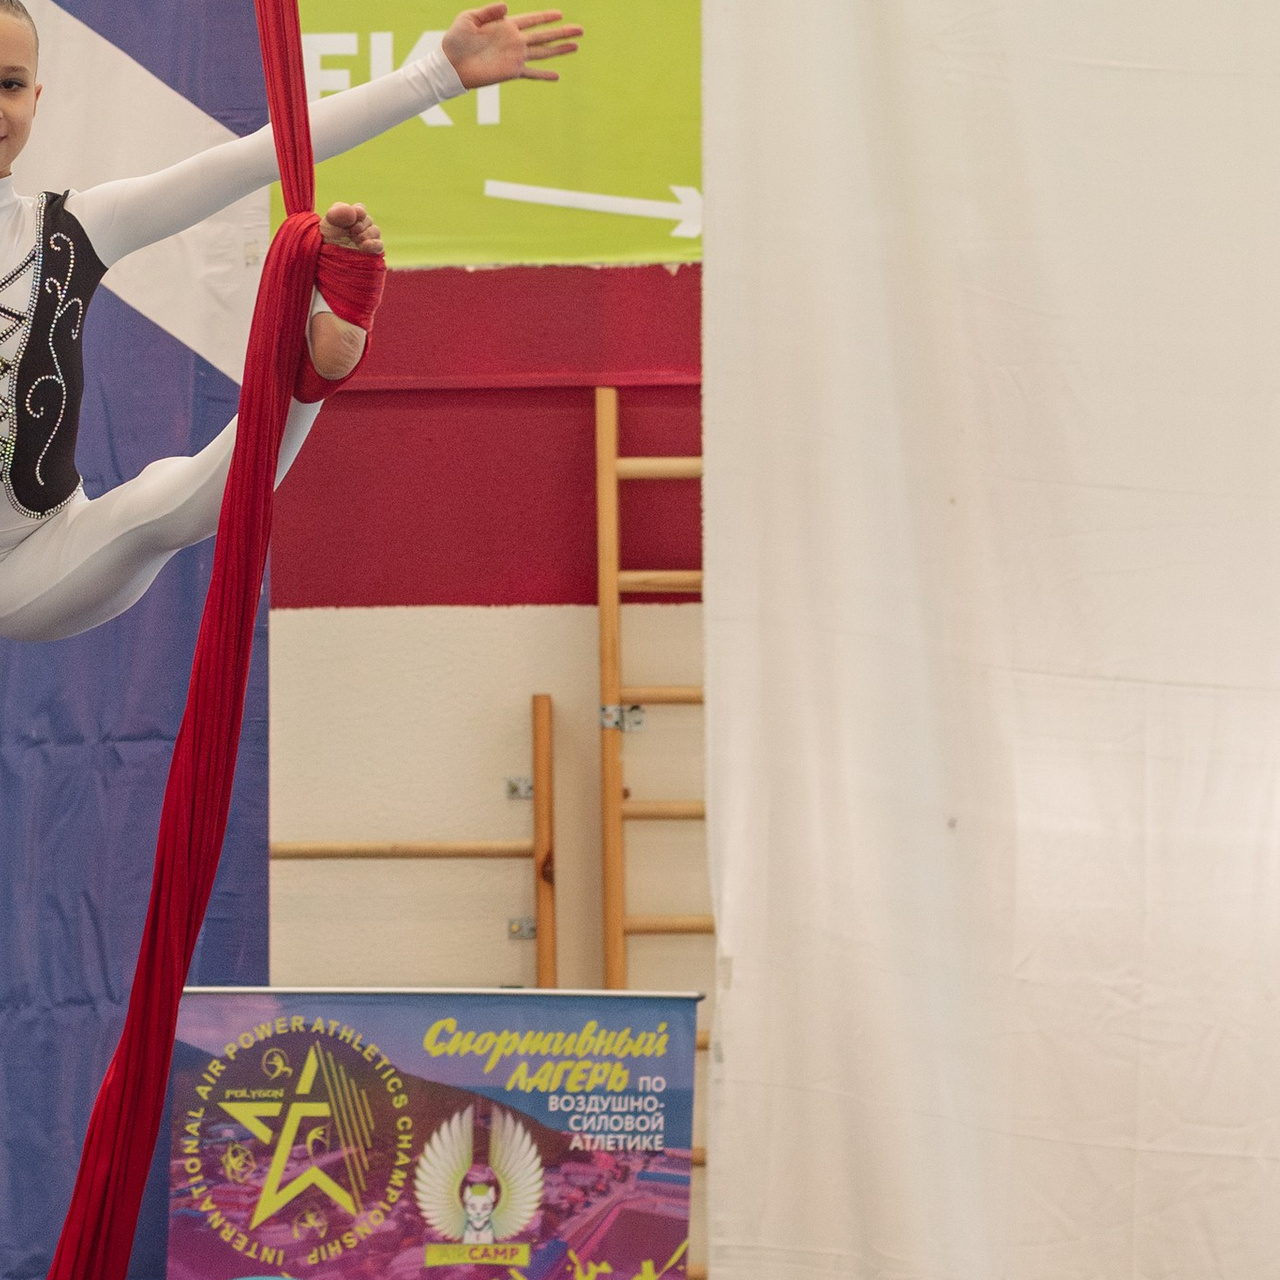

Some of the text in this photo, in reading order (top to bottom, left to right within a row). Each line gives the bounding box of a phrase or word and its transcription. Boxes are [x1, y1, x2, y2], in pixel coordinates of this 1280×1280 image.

[423, 1018, 669, 1074] Спортивный
[506, 1060, 667, 1093] ЛАГЕРЬ ПО
[548, 1095, 666, 1114] ВОЗДУШНО-
[568, 1114, 665, 1132] СИЛОВОЙ
[183, 1015, 413, 1267] INTERNATIONAL AIR POWER ATHLETICS CHAMPIONSHIP
[569, 1134, 664, 1151] АТЛЕТИКЕ
